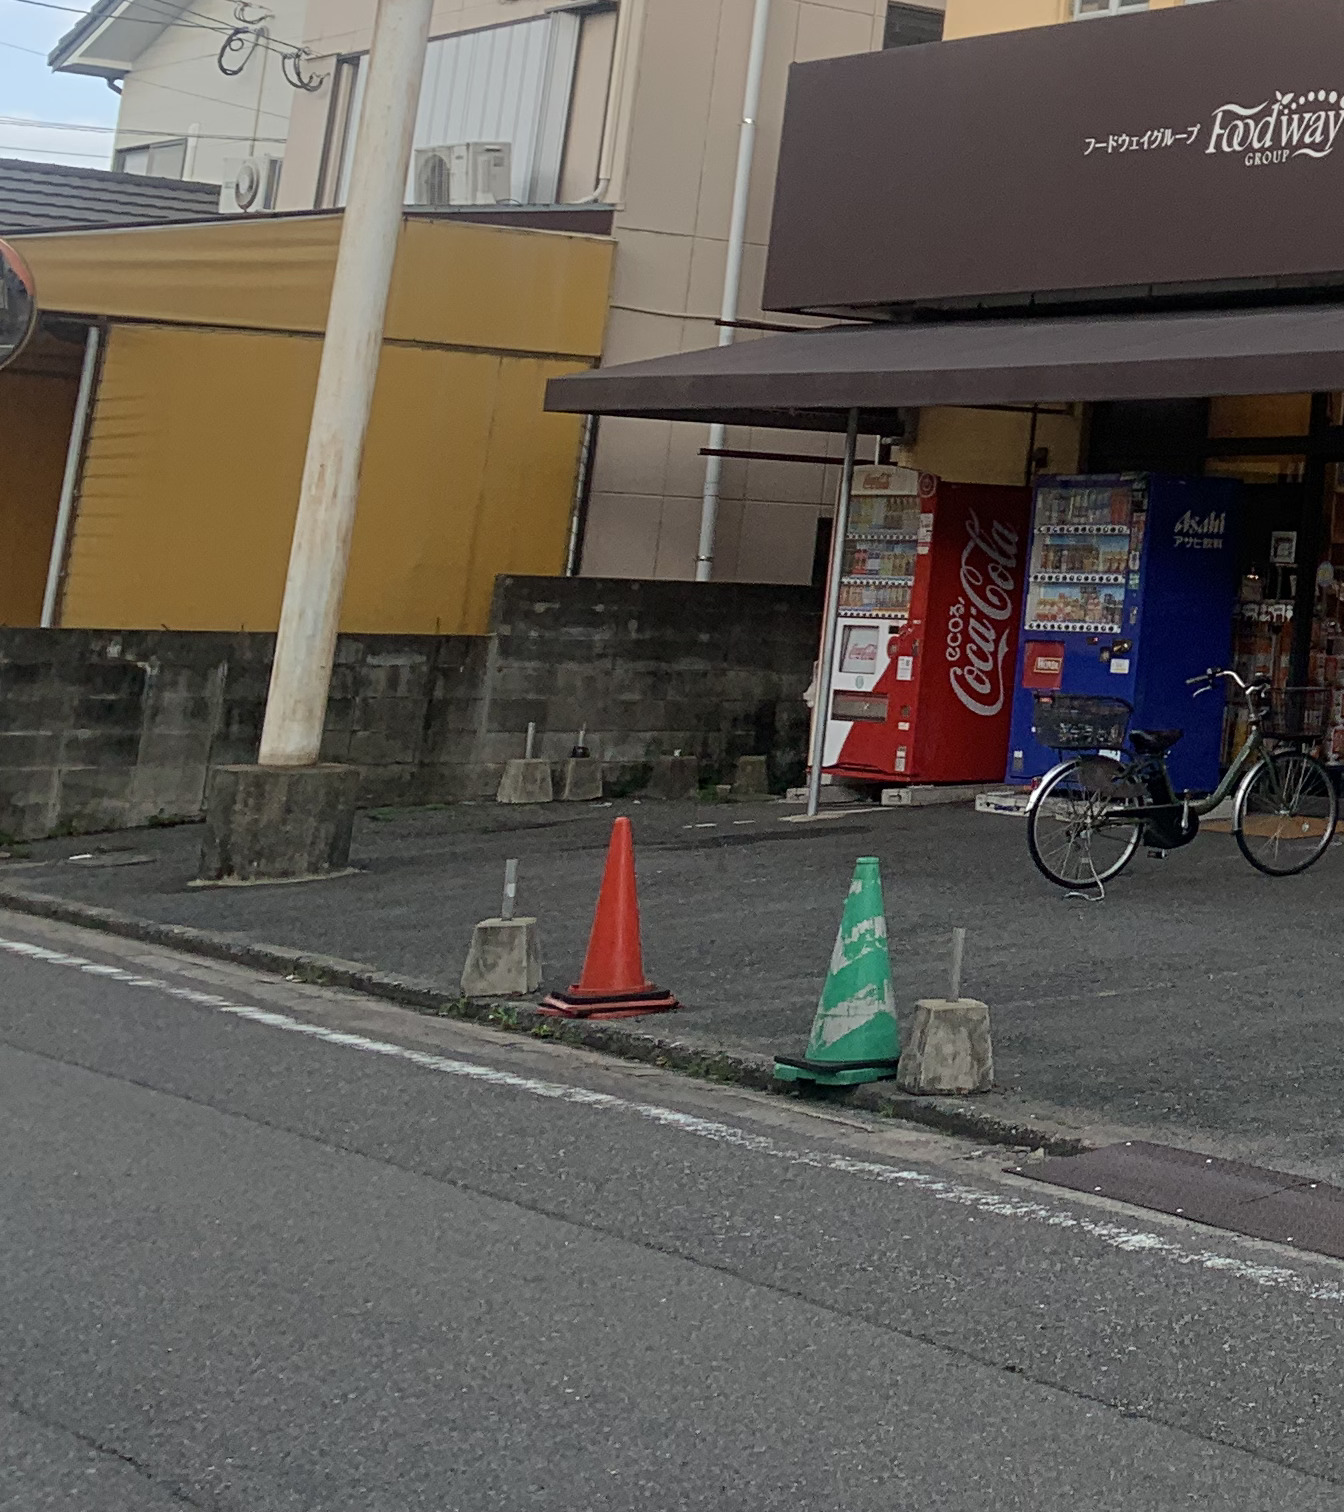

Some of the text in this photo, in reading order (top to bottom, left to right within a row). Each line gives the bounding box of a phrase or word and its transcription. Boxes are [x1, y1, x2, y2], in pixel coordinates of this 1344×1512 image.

[1083, 123, 1200, 156] フードウェイグループ
[1244, 148, 1290, 167] GROUP
[1174, 509, 1226, 534] Asahi
